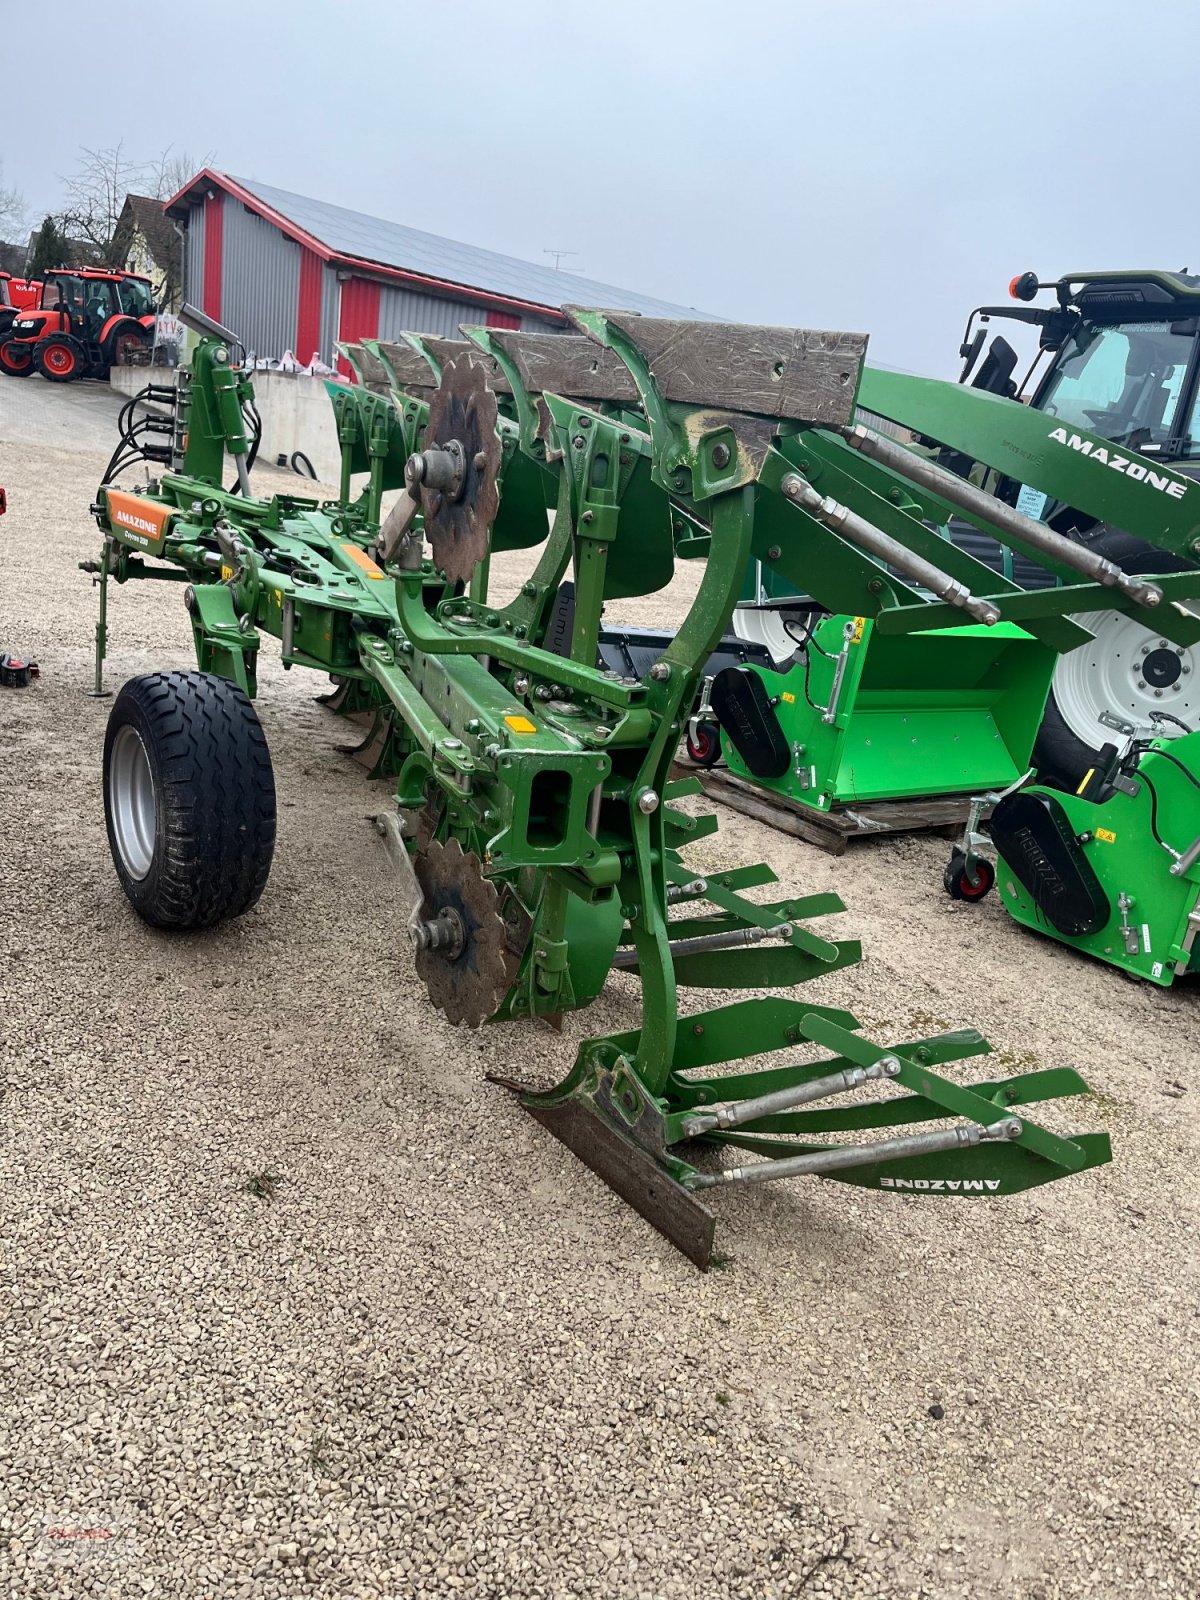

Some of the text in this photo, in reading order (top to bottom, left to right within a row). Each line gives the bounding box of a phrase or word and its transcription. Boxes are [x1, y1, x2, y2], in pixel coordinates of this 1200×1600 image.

[1047, 427, 1188, 500] AMAZONE
[116, 510, 158, 535] AMAZONE
[880, 1177, 1000, 1190] AMAZONE
